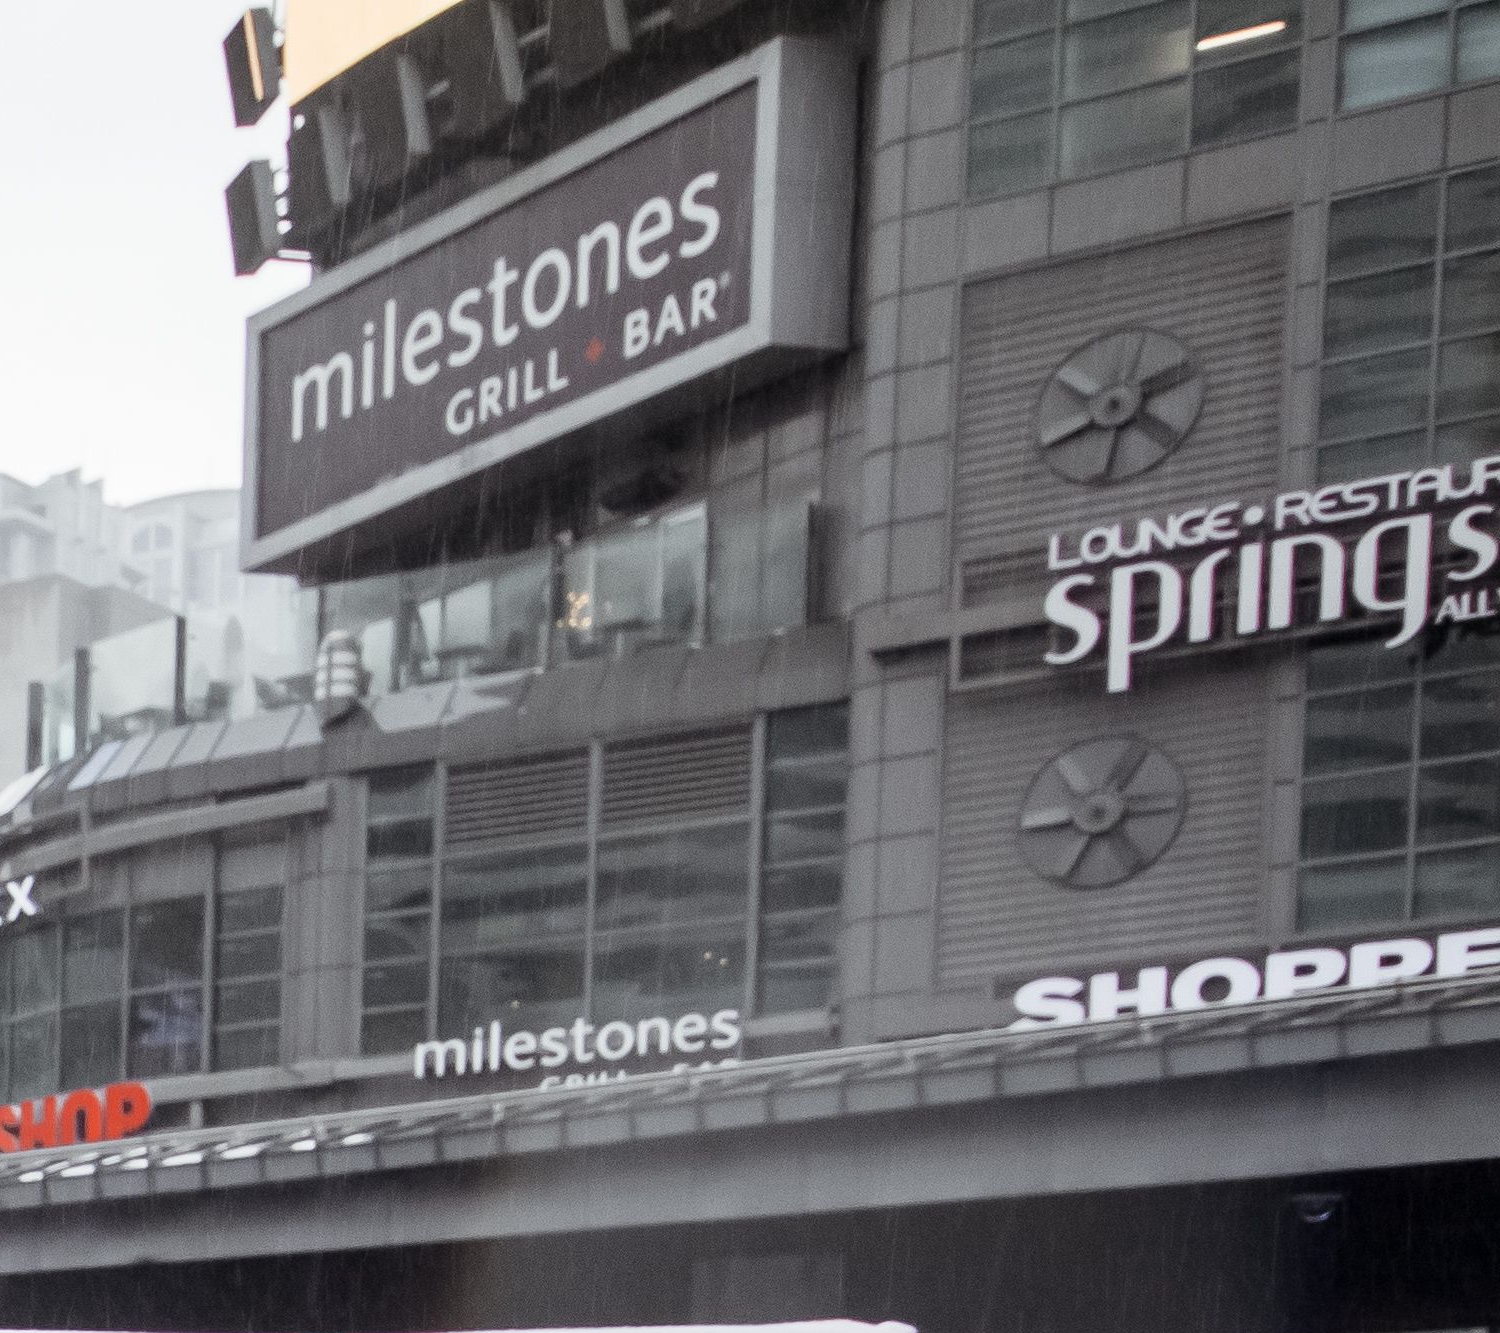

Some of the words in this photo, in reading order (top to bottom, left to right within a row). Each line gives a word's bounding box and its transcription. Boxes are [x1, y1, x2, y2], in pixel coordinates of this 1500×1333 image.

[291, 172, 721, 443] milestones
[446, 349, 570, 436] GRILL
[1049, 501, 1239, 571] LOUNGE
[1043, 505, 1500, 693] springs
[414, 1009, 741, 1079] milestones
